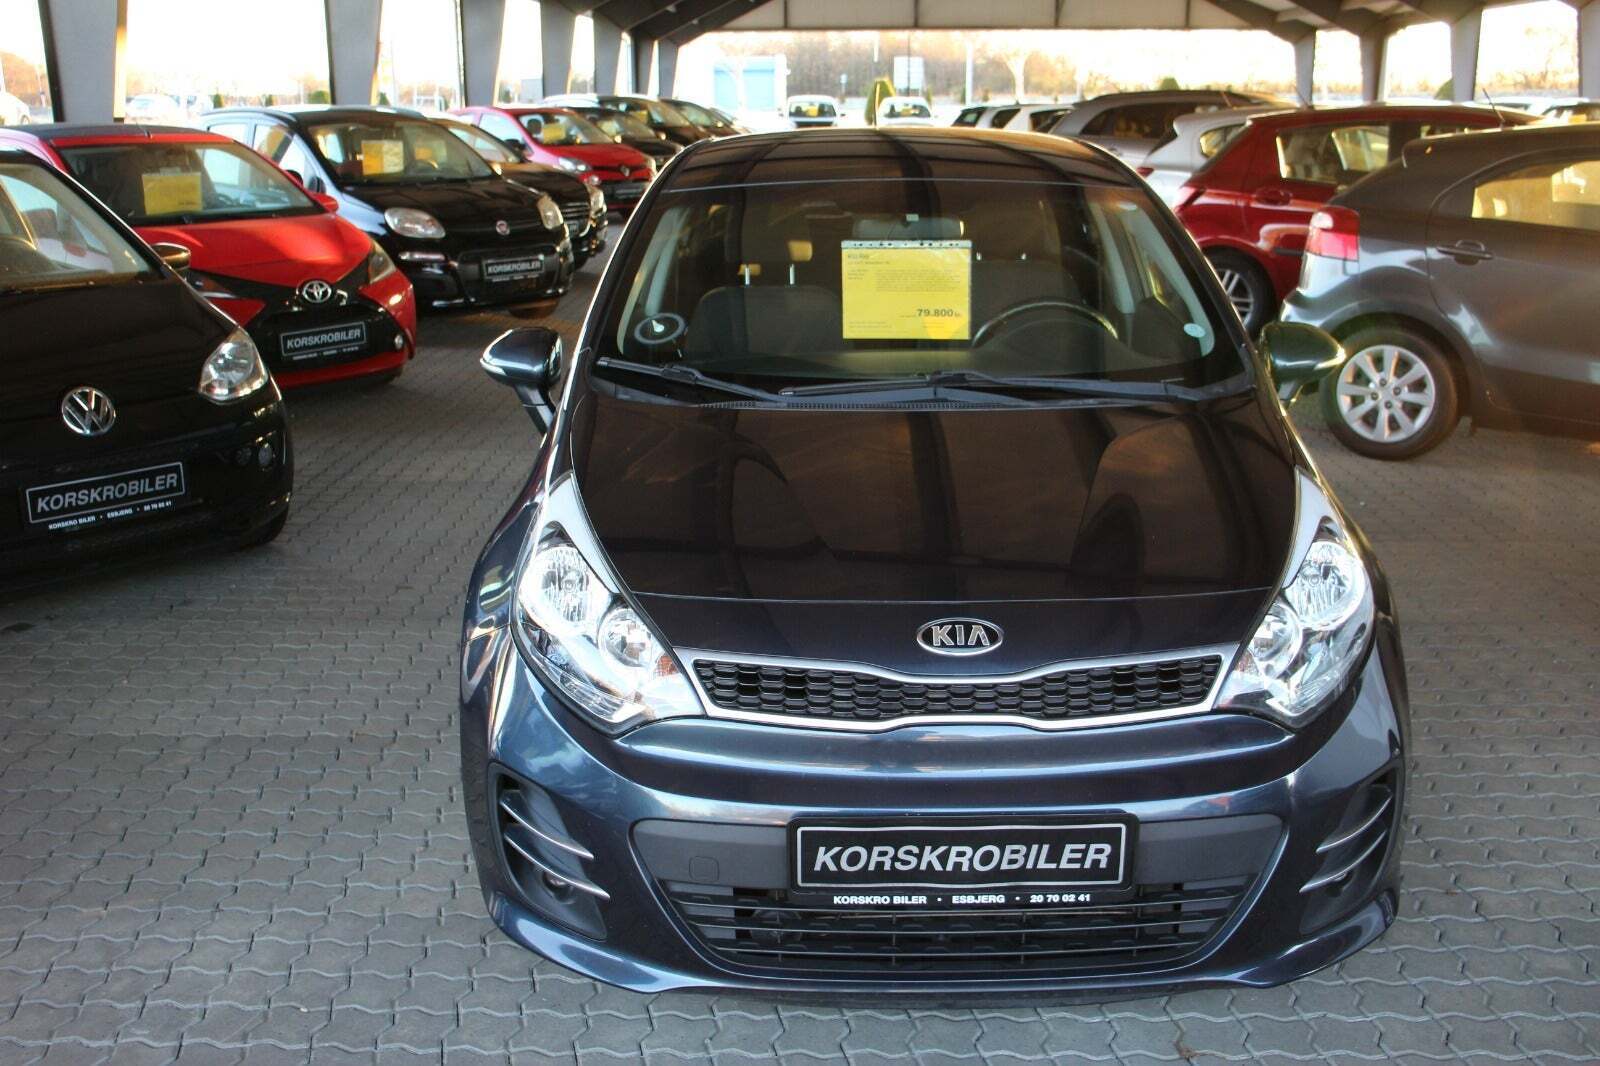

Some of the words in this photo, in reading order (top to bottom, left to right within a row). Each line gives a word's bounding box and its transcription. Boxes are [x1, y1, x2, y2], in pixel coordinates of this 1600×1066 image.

[917, 308, 954, 318] 79.800
[286, 328, 361, 349] KORSKROBILER
[37, 473, 178, 513] KORSKROBILER
[931, 624, 990, 647] KIA
[813, 843, 1112, 872] KORSKROBILER
[833, 895, 890, 904] KORSKRO
[893, 895, 927, 904] BILER
[952, 895, 1005, 904] ESBJERG
[1030, 894, 1044, 903] 20
[1046, 894, 1059, 903] 70
[1061, 894, 1075, 902] 02
[1077, 893, 1090, 902] 41
